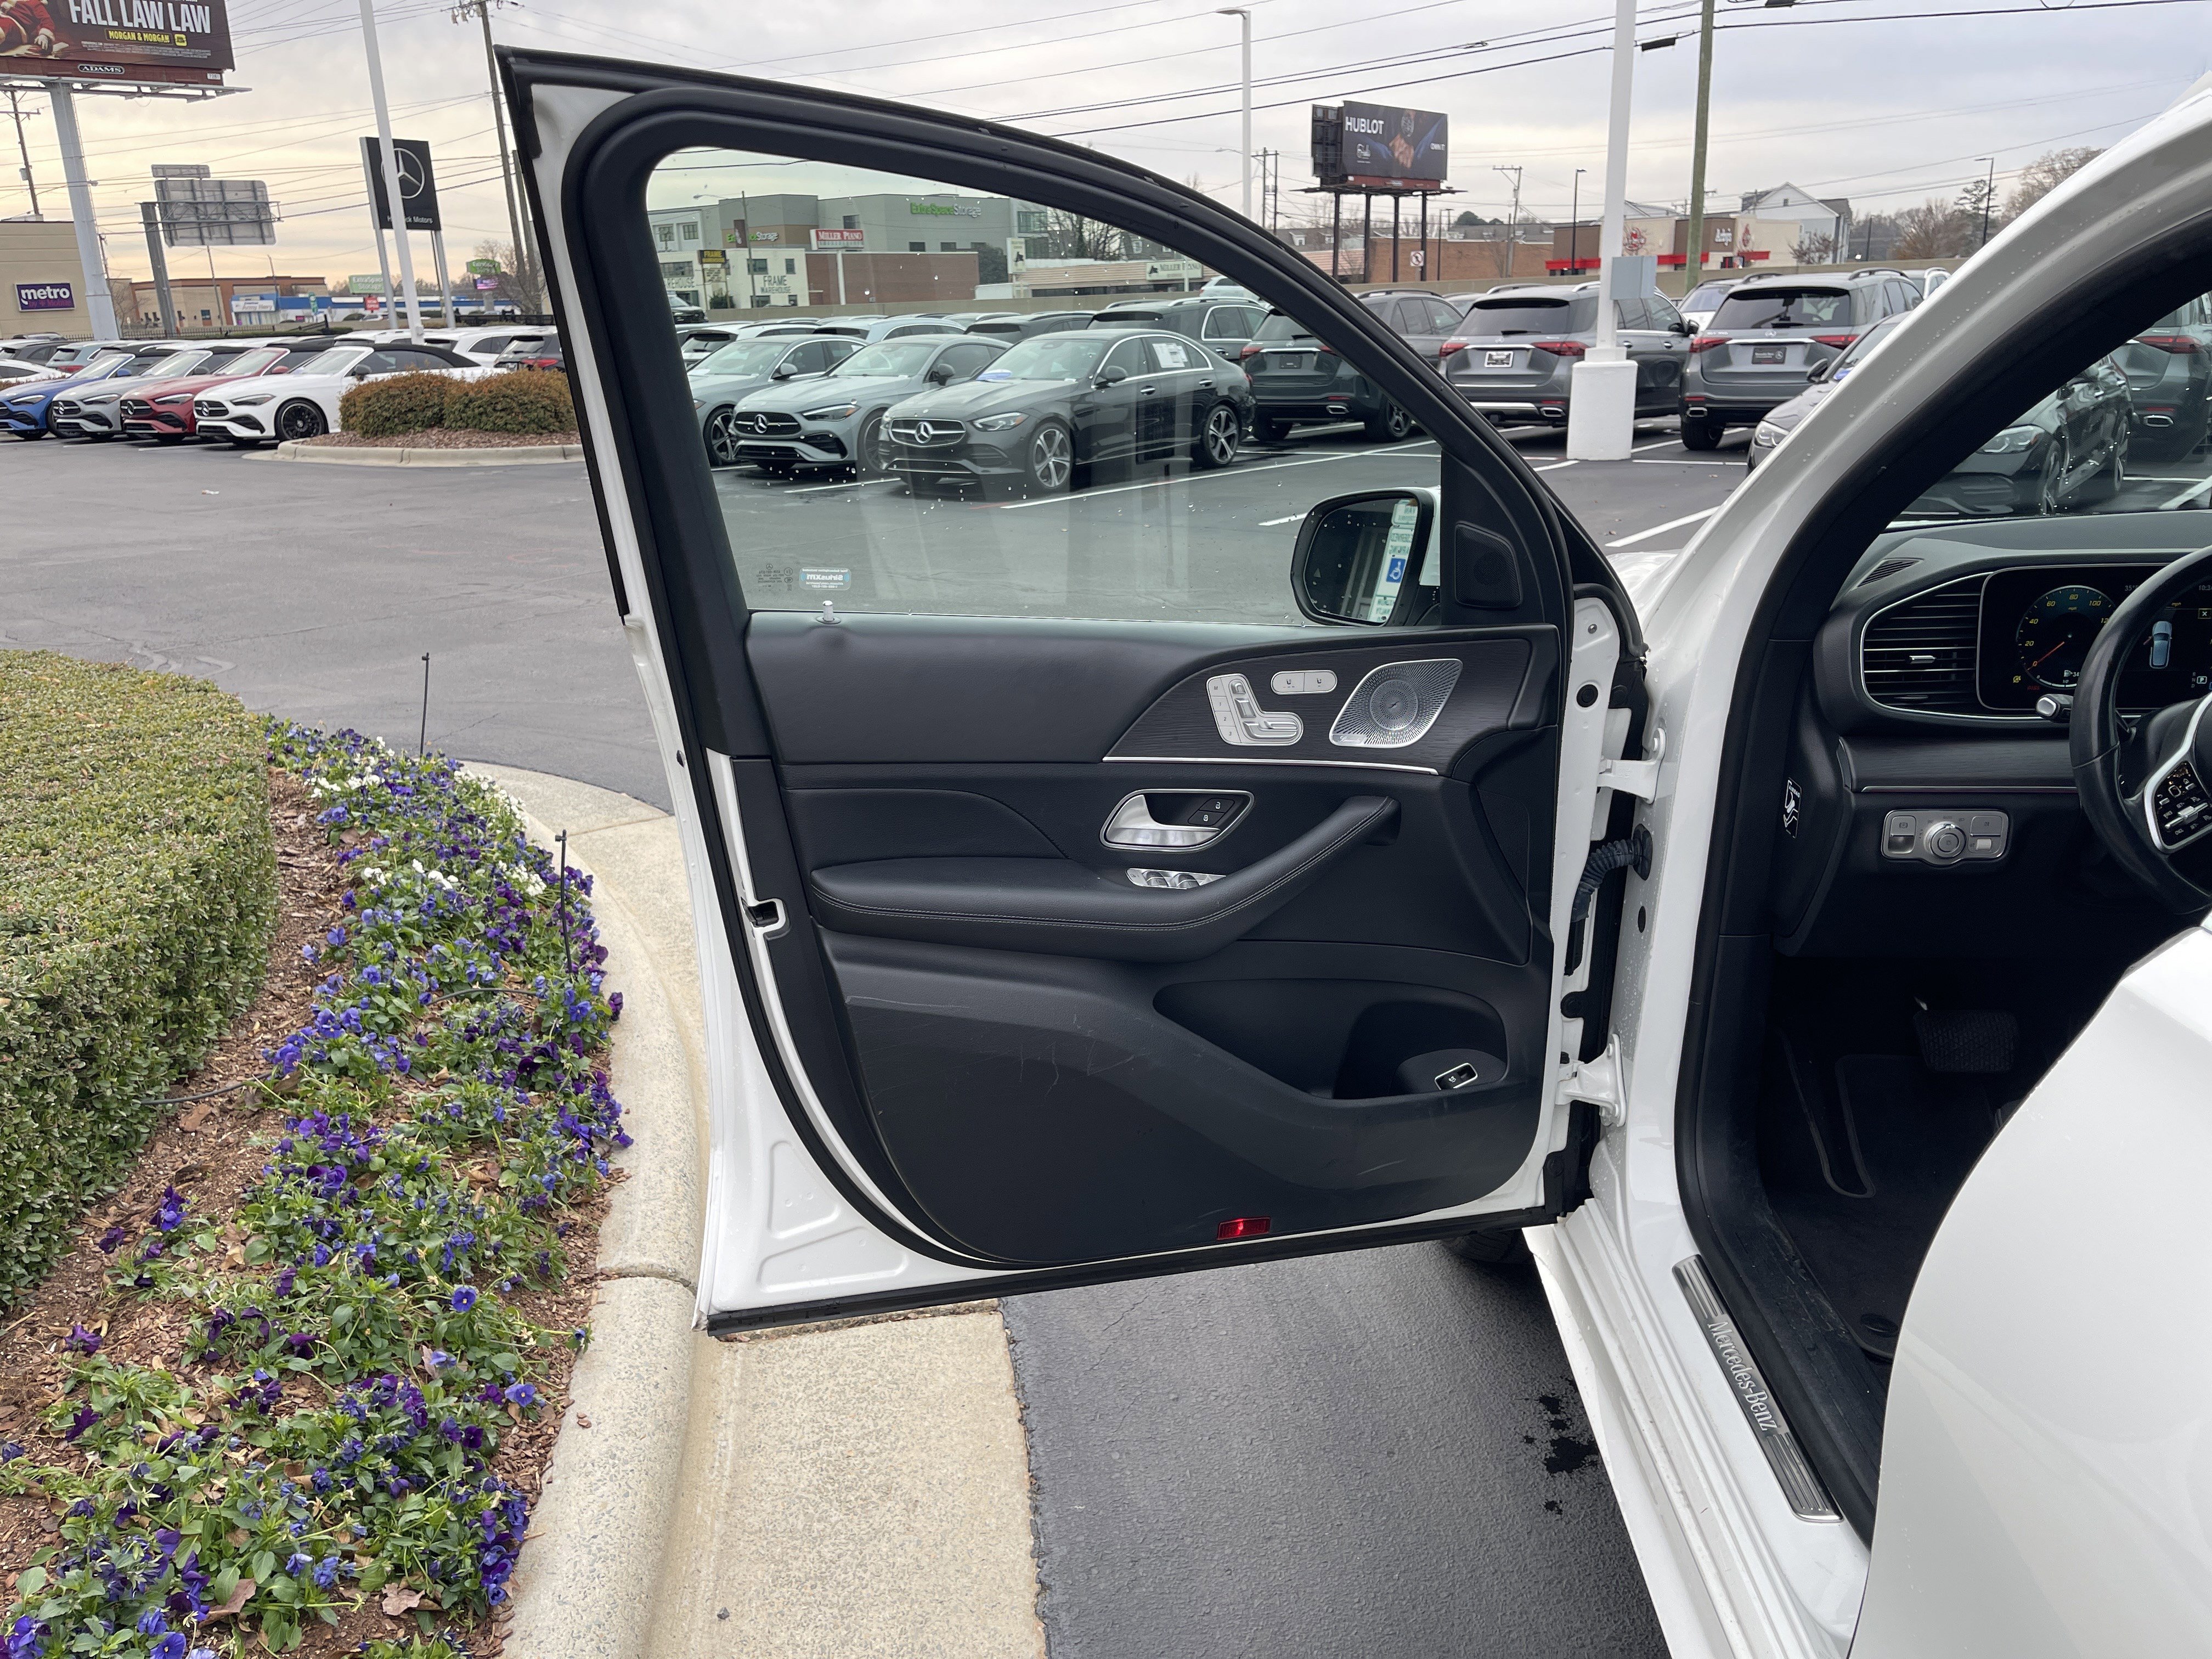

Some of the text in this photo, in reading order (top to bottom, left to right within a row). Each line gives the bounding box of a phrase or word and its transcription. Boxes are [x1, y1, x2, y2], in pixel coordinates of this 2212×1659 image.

[69, 0, 211, 33] FALL LAW LAW
[109, 30, 137, 41] MORGAN
[137, 32, 143, 41] &
[143, 33, 170, 43] MORGAN
[1345, 116, 1384, 134] HUBLOT
[21, 286, 70, 300] metro
[1707, 1320, 1778, 1432] Mercedes-Benz
